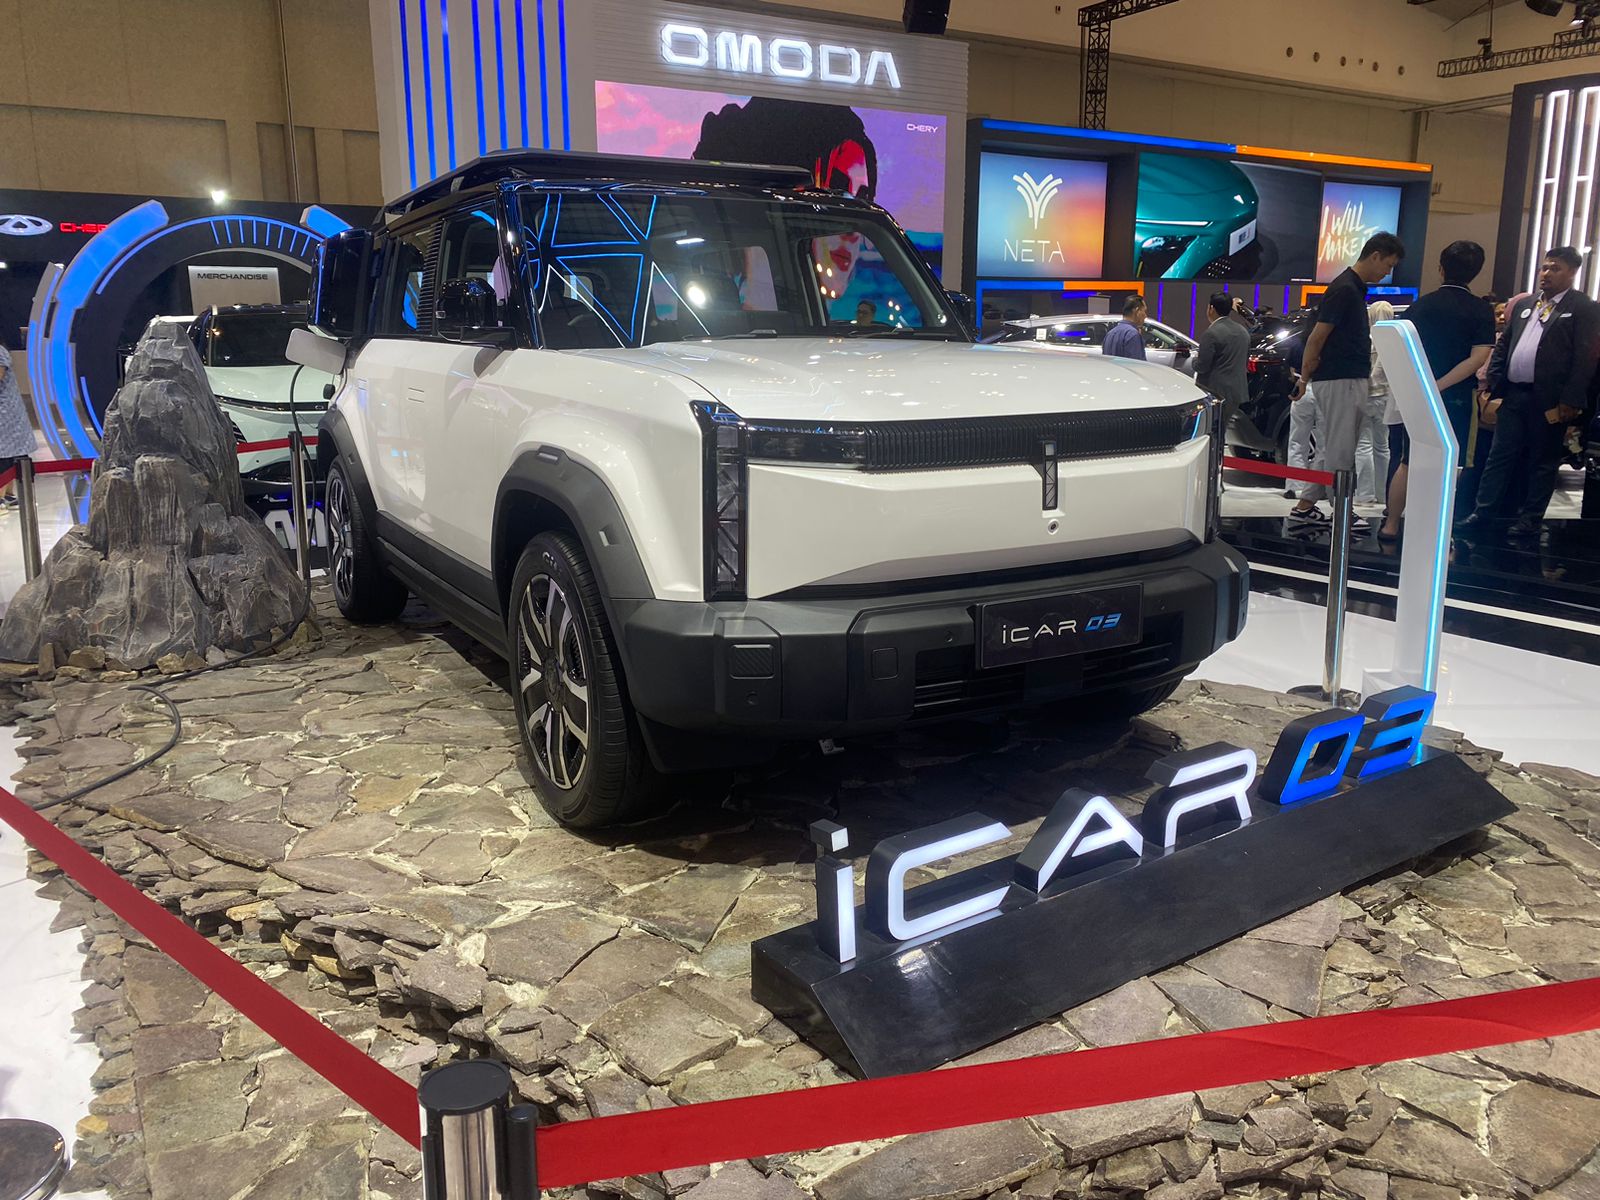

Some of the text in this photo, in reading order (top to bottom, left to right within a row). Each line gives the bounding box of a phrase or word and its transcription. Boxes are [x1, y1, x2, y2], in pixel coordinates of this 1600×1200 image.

[660, 23, 902, 89] OMODA
[906, 123, 938, 132] CHERY
[60, 222, 108, 233] CHER
[1331, 200, 1365, 236] WILL
[1003, 238, 1065, 263] NETA
[1318, 231, 1360, 263] MAKE
[197, 272, 268, 280] MERCHANDISE
[1002, 612, 1122, 644] iCAR 03
[828, 691, 1437, 964] iCAR 03
